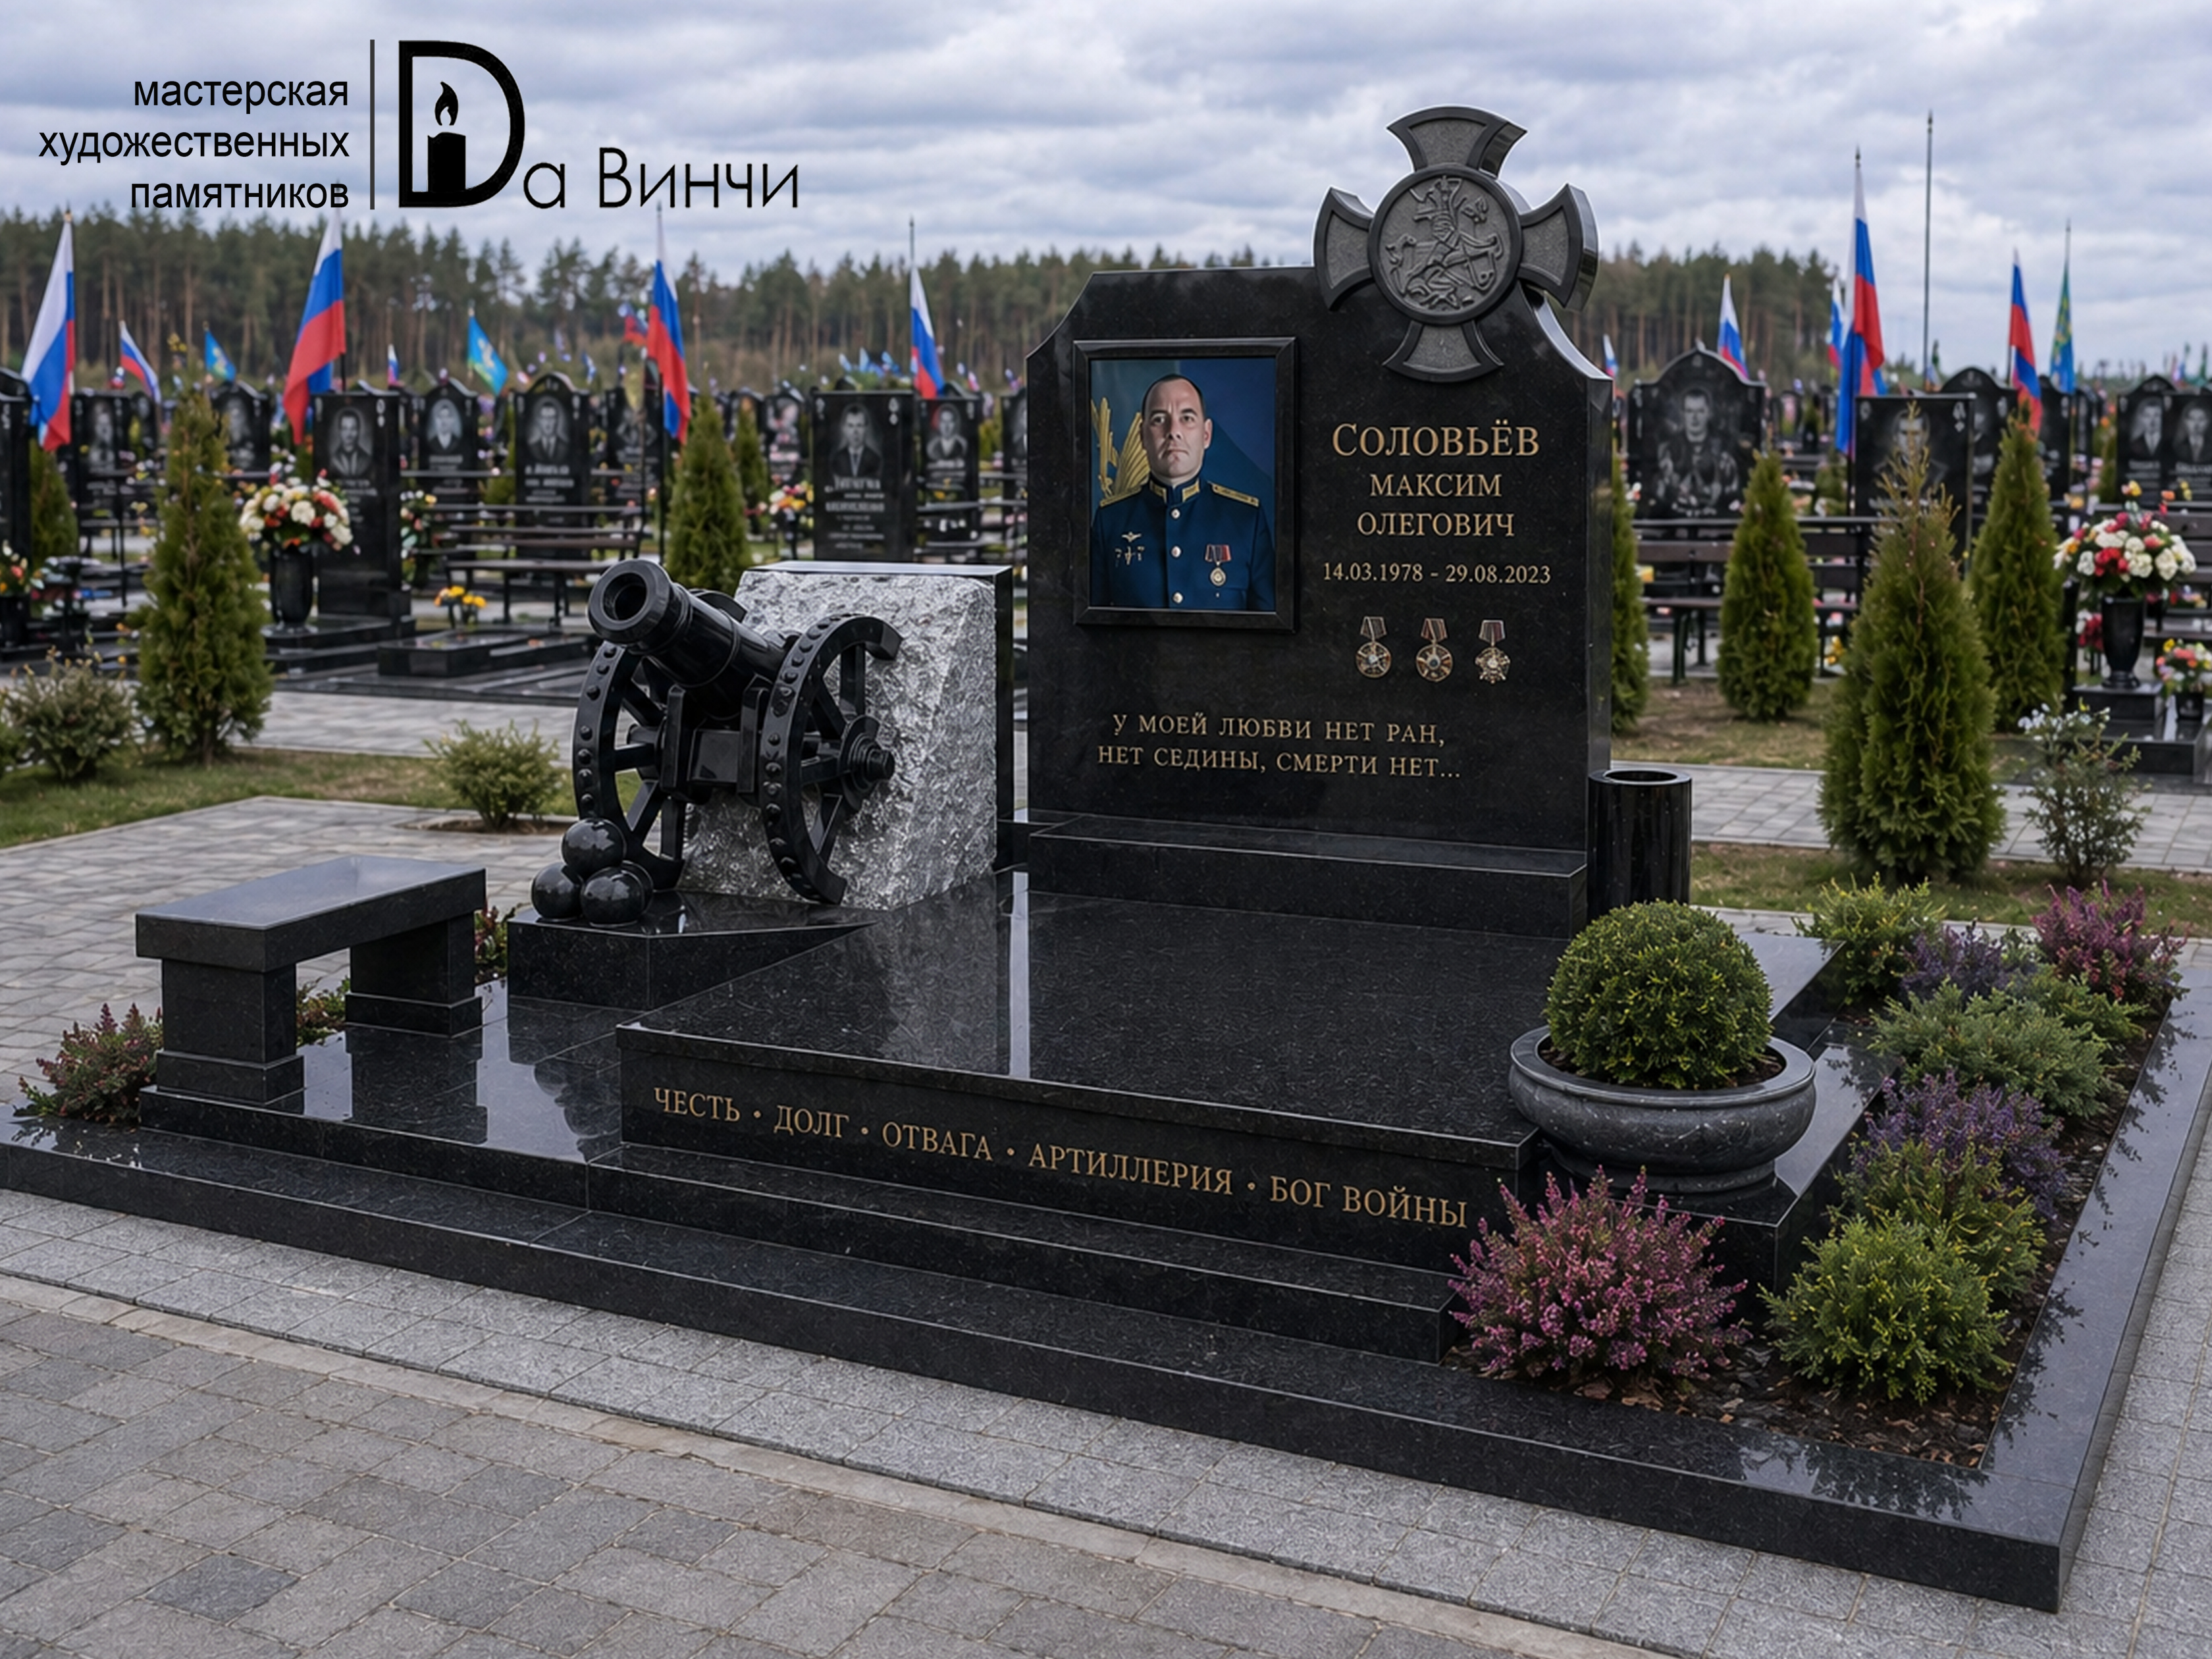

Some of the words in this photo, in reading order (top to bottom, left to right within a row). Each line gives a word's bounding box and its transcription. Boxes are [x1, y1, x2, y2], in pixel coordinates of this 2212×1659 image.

[1369, 473, 1503, 498] МАКСИМ
[1356, 512, 1515, 537] ОЛЕГОВИЧ
[1323, 562, 1423, 582] 14.03.1978
[1445, 564, 1552, 585] 29.08.2023
[1113, 714, 1128, 736] У
[1138, 712, 1207, 735] МОЕЙ
[1219, 717, 1312, 740] ЛЮБВИ
[1325, 721, 1375, 741] НЕТ
[1386, 724, 1444, 747] РАН,
[1097, 745, 1144, 766] НЕТ
[1153, 748, 1266, 773] СЕДИНЫ,
[1276, 752, 1379, 776] СМЕРТИ
[1388, 756, 1460, 778] НЕТ...
[654, 1086, 741, 1122] ЧЕСТЬ
[773, 1105, 850, 1139] ДОЛГ
[882, 1120, 993, 1161] ОТВАГА
[1028, 1142, 1233, 1196] АРТИЛЛЕРИЯ
[1270, 1174, 1331, 1209] БОГ
[1342, 1184, 1468, 1228] ВОЙНЫ
